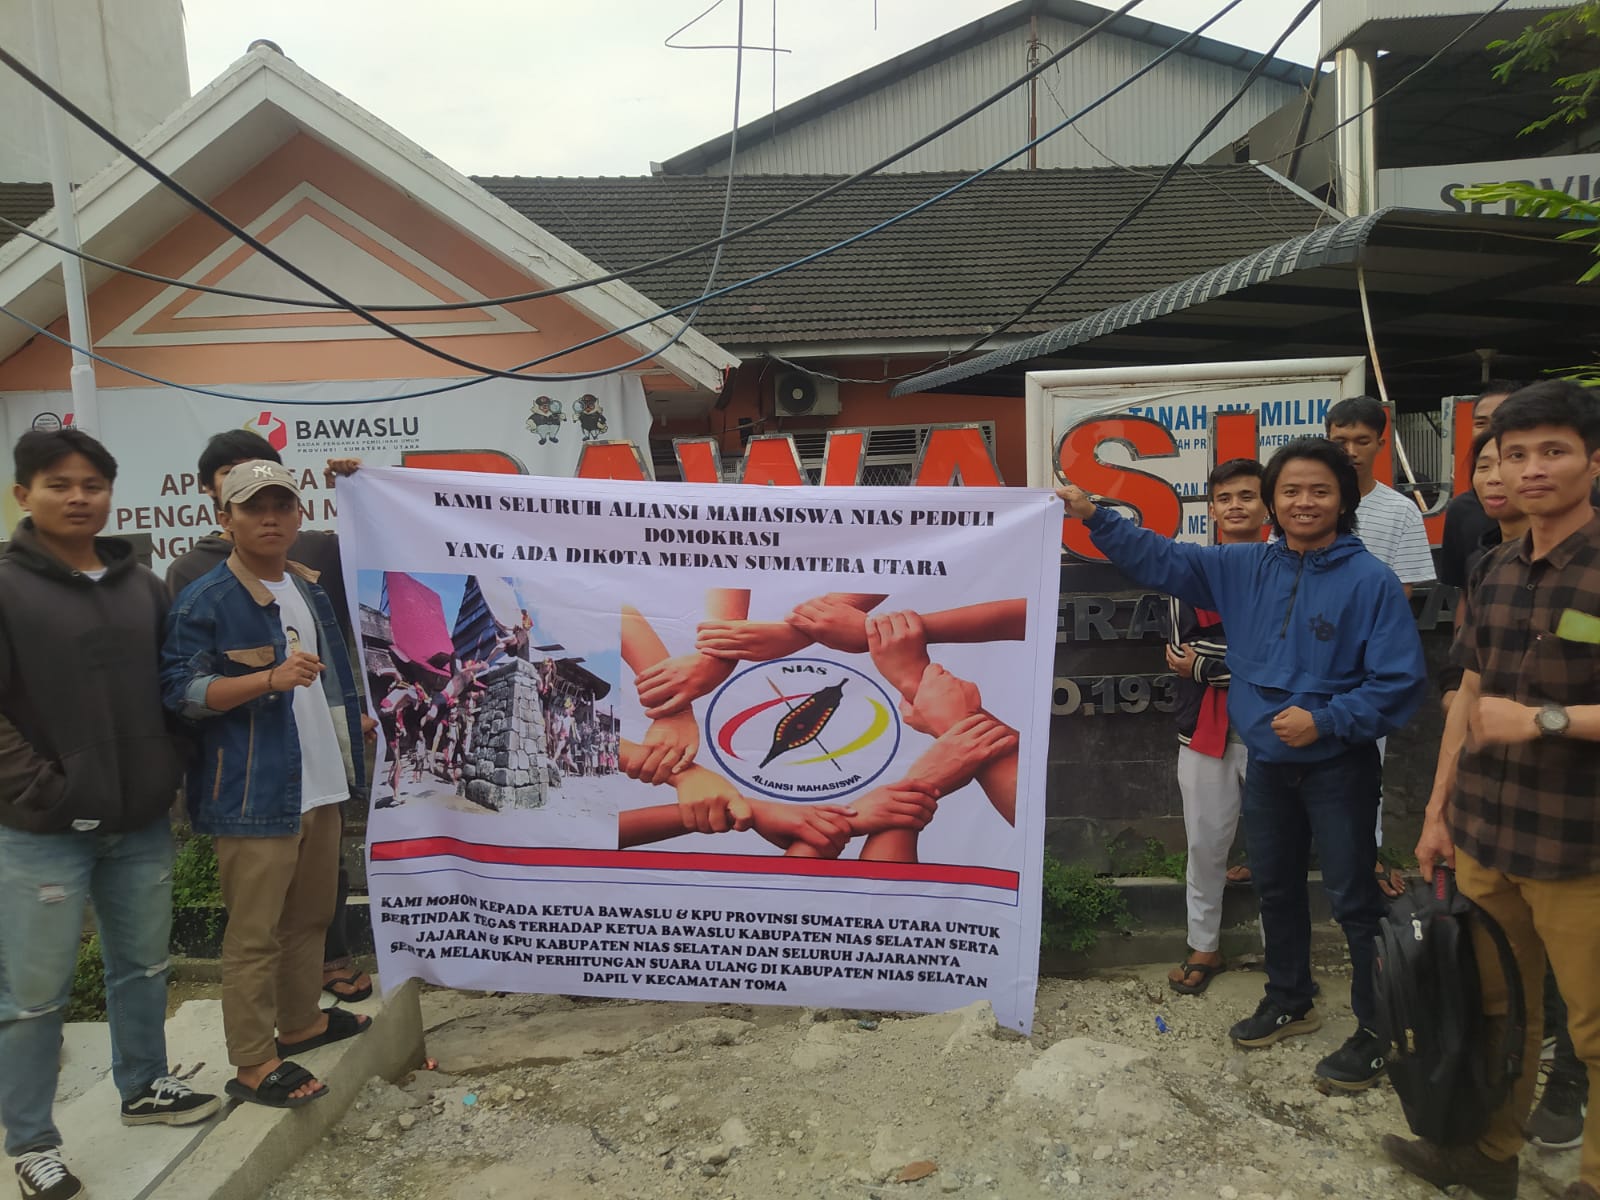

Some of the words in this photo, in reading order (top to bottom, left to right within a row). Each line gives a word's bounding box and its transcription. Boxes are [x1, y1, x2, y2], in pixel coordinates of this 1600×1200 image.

[296, 417, 419, 439] BAWASLU
[1261, 398, 1332, 427] MILIK
[434, 492, 492, 510] KAMI
[500, 496, 601, 516] SELURUH
[609, 502, 698, 520] ALIANSI
[706, 505, 843, 524] MAHASISWA
[850, 508, 903, 526] NIAS
[910, 510, 995, 526] PEDULI
[645, 528, 780, 546] DOMOKRASI
[445, 542, 504, 559] YANG
[512, 545, 558, 562] ADA
[566, 548, 652, 566] DIKOTA
[659, 552, 738, 569] MEDAN
[745, 554, 865, 574] SUMATERA
[873, 558, 948, 576] UTARA
[782, 665, 828, 675] NIAS
[752, 774, 794, 792] ALIANSI
[796, 774, 862, 792] MAHASISWA
[381, 896, 422, 908] KAMI
[426, 894, 478, 906] MOHON
[480, 900, 538, 916] KEPADA
[542, 905, 594, 916] KETUA
[599, 906, 673, 919] BAWASLU
[676, 909, 688, 920] &
[692, 910, 722, 921] KPU
[726, 912, 798, 924] PROVINSI
[800, 914, 884, 929] SUMATERA
[888, 918, 941, 932] UTARA
[946, 922, 1000, 938] UNTUK
[381, 912, 470, 925] BERTINDAK
[474, 914, 516, 929] TEGAS
[519, 920, 602, 934] TERHADAP
[606, 924, 658, 936] KETUA
[662, 926, 735, 938] BAWASLU
[739, 928, 832, 942] KABUPATEN
[836, 933, 872, 945] NIAS
[876, 935, 946, 949] SELATAN
[950, 939, 999, 956] SERTA
[416, 929, 487, 943] JAJARAN
[490, 934, 498, 944] &
[503, 935, 532, 947] KPU
[536, 938, 629, 951] KABUPATEN
[634, 942, 670, 954] NIAS
[674, 943, 742, 956] SELATAN
[746, 946, 778, 958] DAN
[782, 948, 852, 962] SELURUH
[856, 952, 960, 968] JAJARANNYA
[390, 941, 436, 959] SERTA
[440, 946, 532, 963] MELAKUKAN
[536, 954, 646, 968] PERHITUNGAN
[650, 958, 701, 970] SUARA
[705, 960, 758, 974] ULANG
[761, 964, 776, 974] DI
[780, 964, 873, 980] KABUPATEN
[878, 969, 914, 982] NIAS
[918, 970, 988, 988] SELATAN
[584, 972, 628, 984] DAPIL
[632, 974, 642, 984] V
[646, 974, 741, 989] KECAMATAN
[744, 978, 787, 992] TOMA
